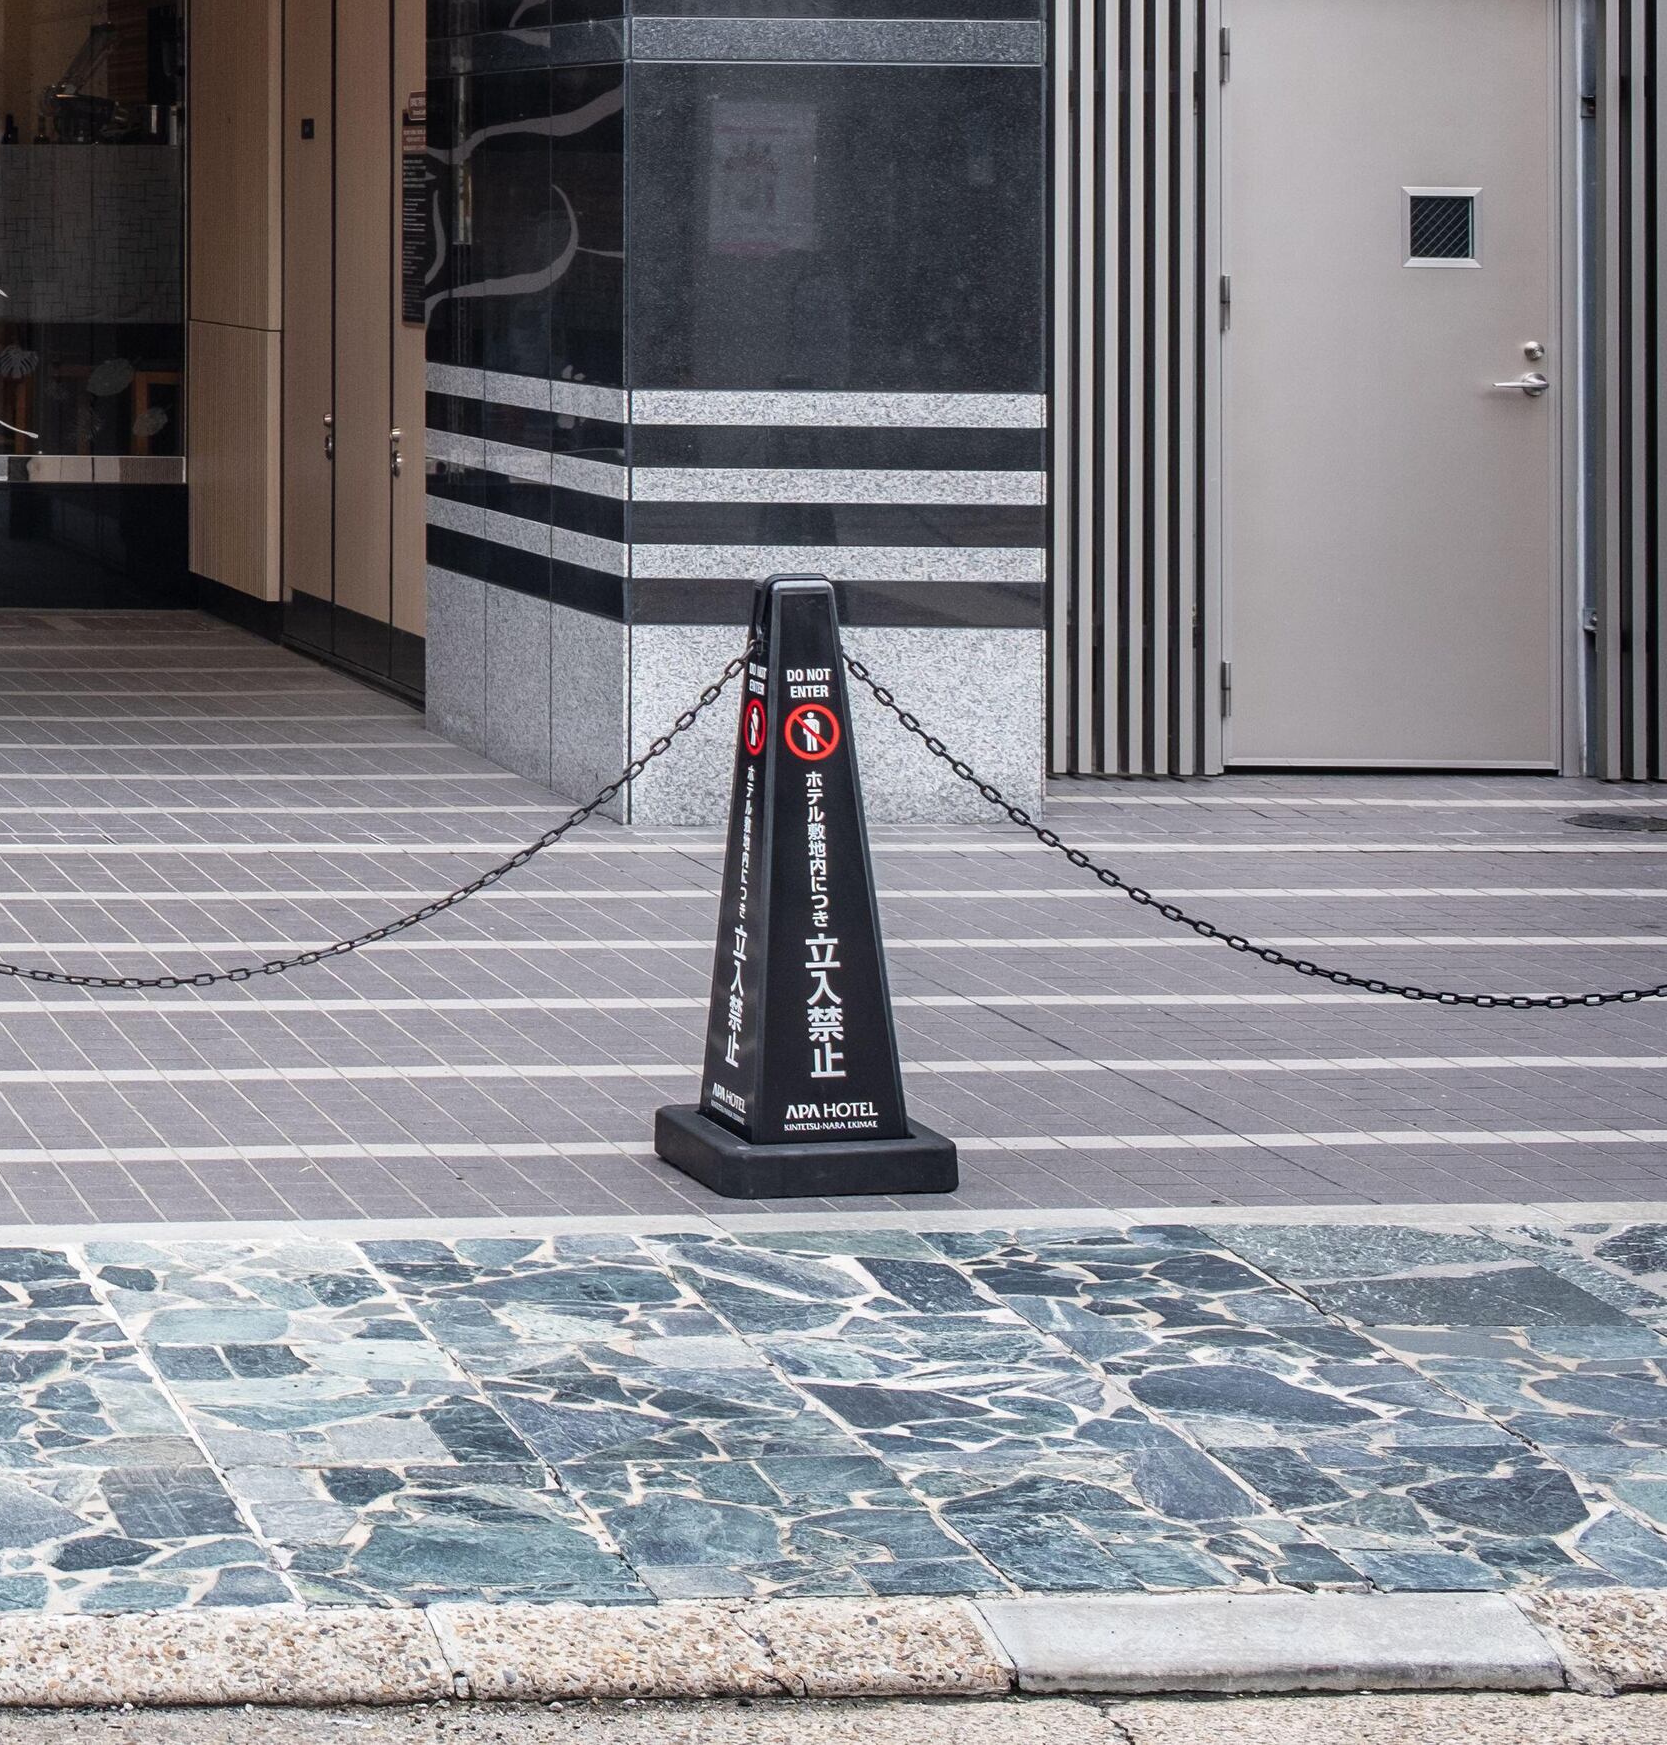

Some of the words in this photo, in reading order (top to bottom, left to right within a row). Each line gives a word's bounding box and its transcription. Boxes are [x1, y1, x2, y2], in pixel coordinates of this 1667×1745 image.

[786, 669, 804, 682] DO
[806, 668, 832, 681] NOT
[790, 685, 829, 698] ENTER
[805, 933, 846, 1078] 立入禁止
[785, 1104, 821, 1120] APA
[823, 1102, 879, 1118] HOTEL
[847, 1120, 879, 1129] EKIMAE
